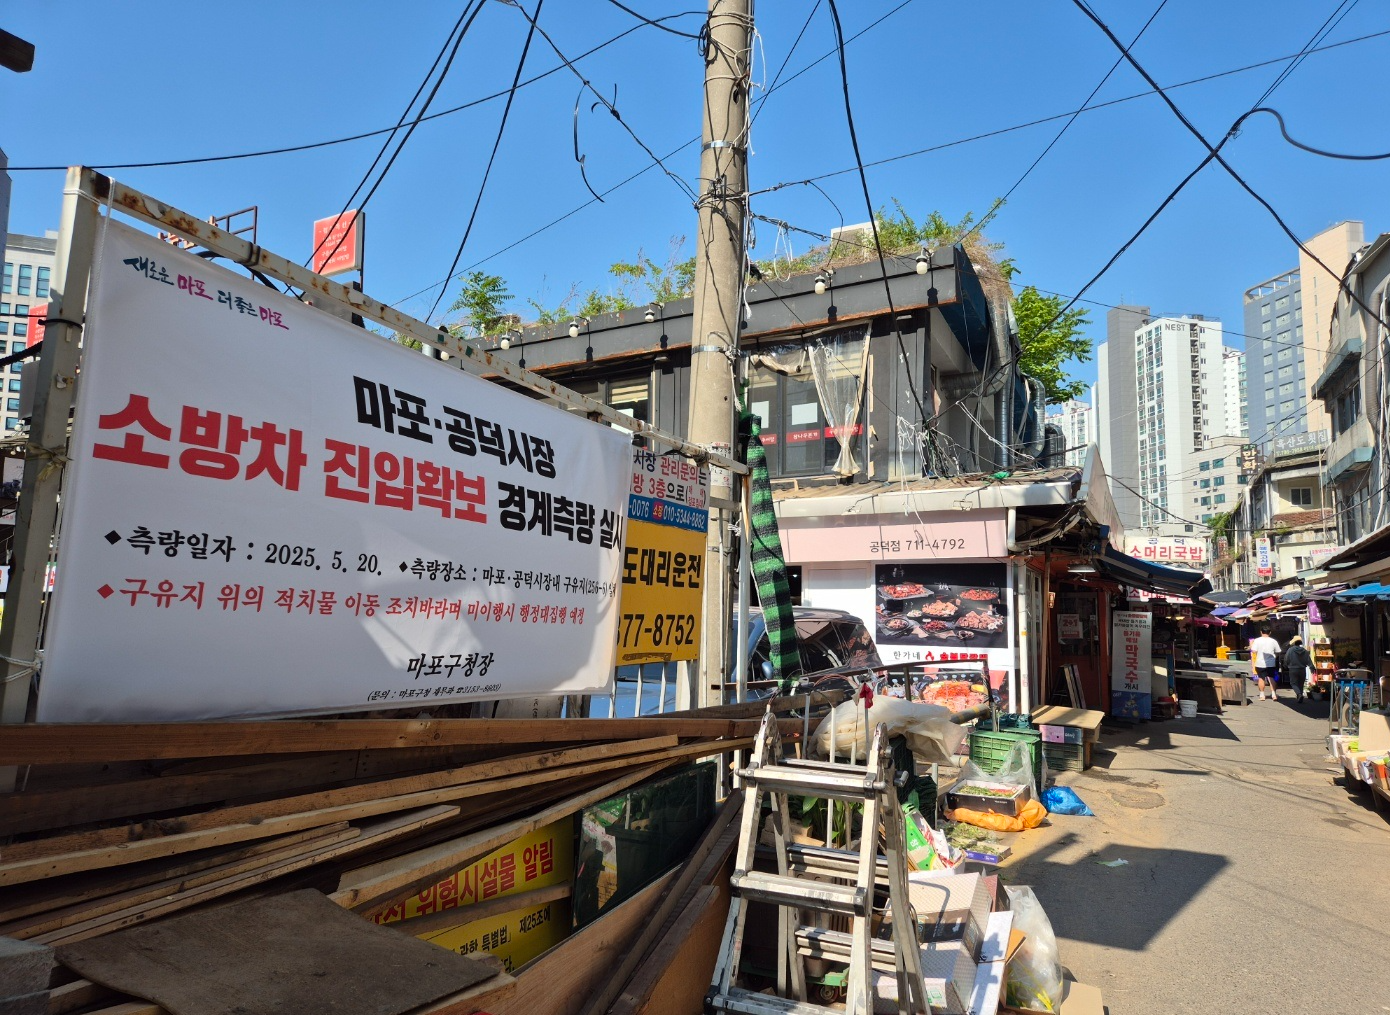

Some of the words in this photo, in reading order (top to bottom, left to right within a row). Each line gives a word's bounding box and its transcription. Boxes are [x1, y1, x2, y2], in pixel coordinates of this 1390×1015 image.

[123, 256, 175, 286] 새로운
[177, 274, 214, 301] 마포
[218, 289, 233, 310] 더
[235, 296, 258, 317] 좋은
[259, 305, 290, 330] 마포
[353, 375, 557, 479] 마포·공덕시장
[92, 393, 308, 492] 소방차
[323, 438, 488, 524] 진입확보
[498, 480, 595, 545] 경계측량
[633, 452, 656, 473] 시장
[660, 456, 707, 487] 관리문의는
[126, 526, 236, 562] 측량일자
[264, 543, 321, 570] 2025.
[331, 551, 348, 573] 5.
[357, 553, 382, 576] 20.
[869, 539, 901, 553] 공덕점
[905, 538, 965, 551] 711-4792
[1130, 545, 1203, 561] 소머리국밥
[410, 558, 467, 582] 측량장소
[482, 566, 561, 592] 마포·공덕시장내
[119, 577, 205, 610] 구유지
[217, 583, 265, 613] 위의
[274, 587, 337, 616] 적치물
[345, 591, 381, 617] 이동
[386, 597, 462, 621] 조치바라며
[467, 600, 516, 625] 미이행시
[519, 605, 568, 627] 행정대집행
[569, 607, 585, 626] 예정
[407, 652, 495, 680] 마포구청장
[893, 650, 920, 660] 한가네
[1125, 644, 1139, 683] 막국수
[399, 687, 431, 700] 마포구청
[1124, 682, 1139, 690] 개시
[523, 838, 554, 882] 알림
